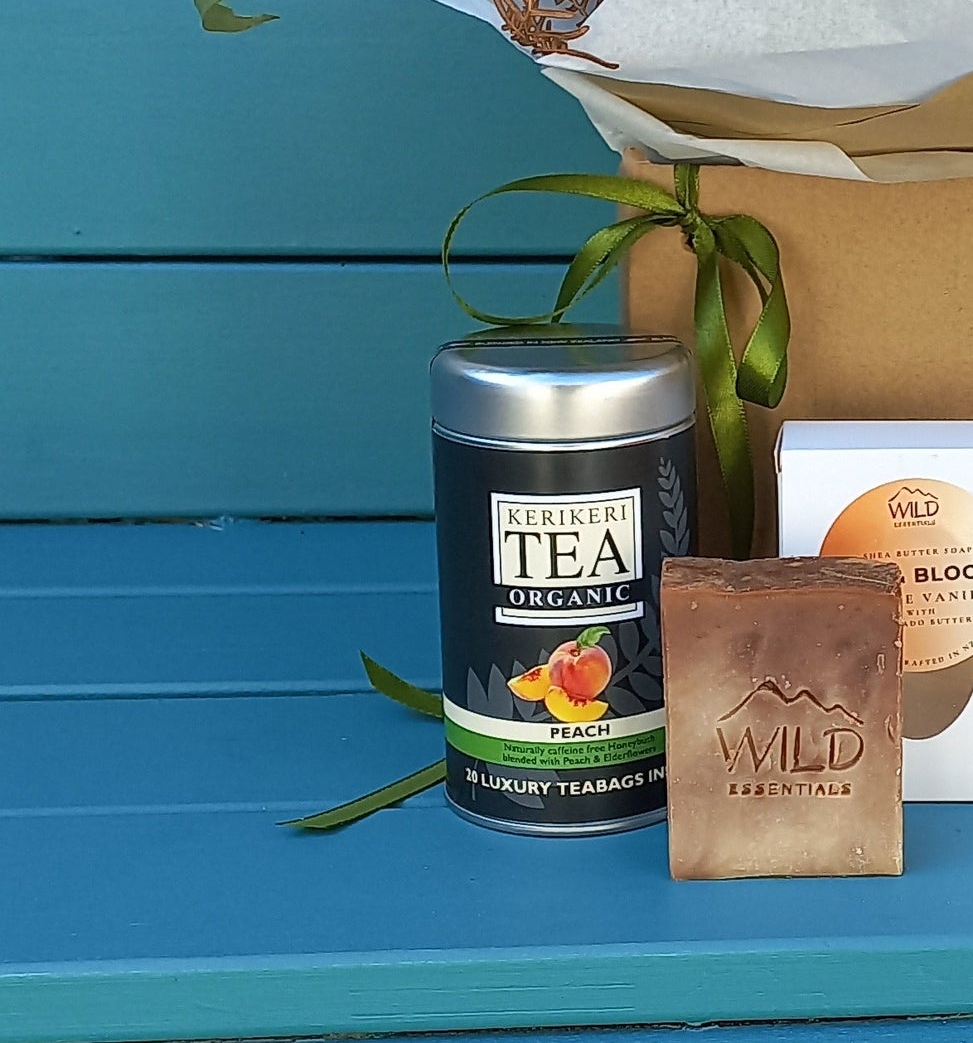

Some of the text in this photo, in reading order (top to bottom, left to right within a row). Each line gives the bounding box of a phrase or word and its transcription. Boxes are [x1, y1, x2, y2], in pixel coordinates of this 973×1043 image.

[508, 504, 627, 526] KERIKERI
[888, 500, 940, 519] WILD
[504, 527, 631, 580] TEA
[896, 548, 940, 558] BUTTER
[943, 546, 973, 555] SOAP
[509, 584, 630, 607] ORGANIC
[906, 608, 936, 617] WITH
[930, 616, 973, 626] BUTTER
[948, 650, 961, 660] IN
[550, 723, 610, 739] PEACH
[502, 746, 657, 766] blended with Peach & Elderflowers
[503, 742, 546, 756] Naturally
[548, 744, 584, 755] caffeine
[587, 743, 606, 754] free
[715, 725, 865, 775] WILD
[464, 767, 478, 784] 20
[481, 774, 552, 796] LUXURY
[557, 772, 645, 796] TEABAGS
[728, 782, 853, 796] ESSENTIALS
